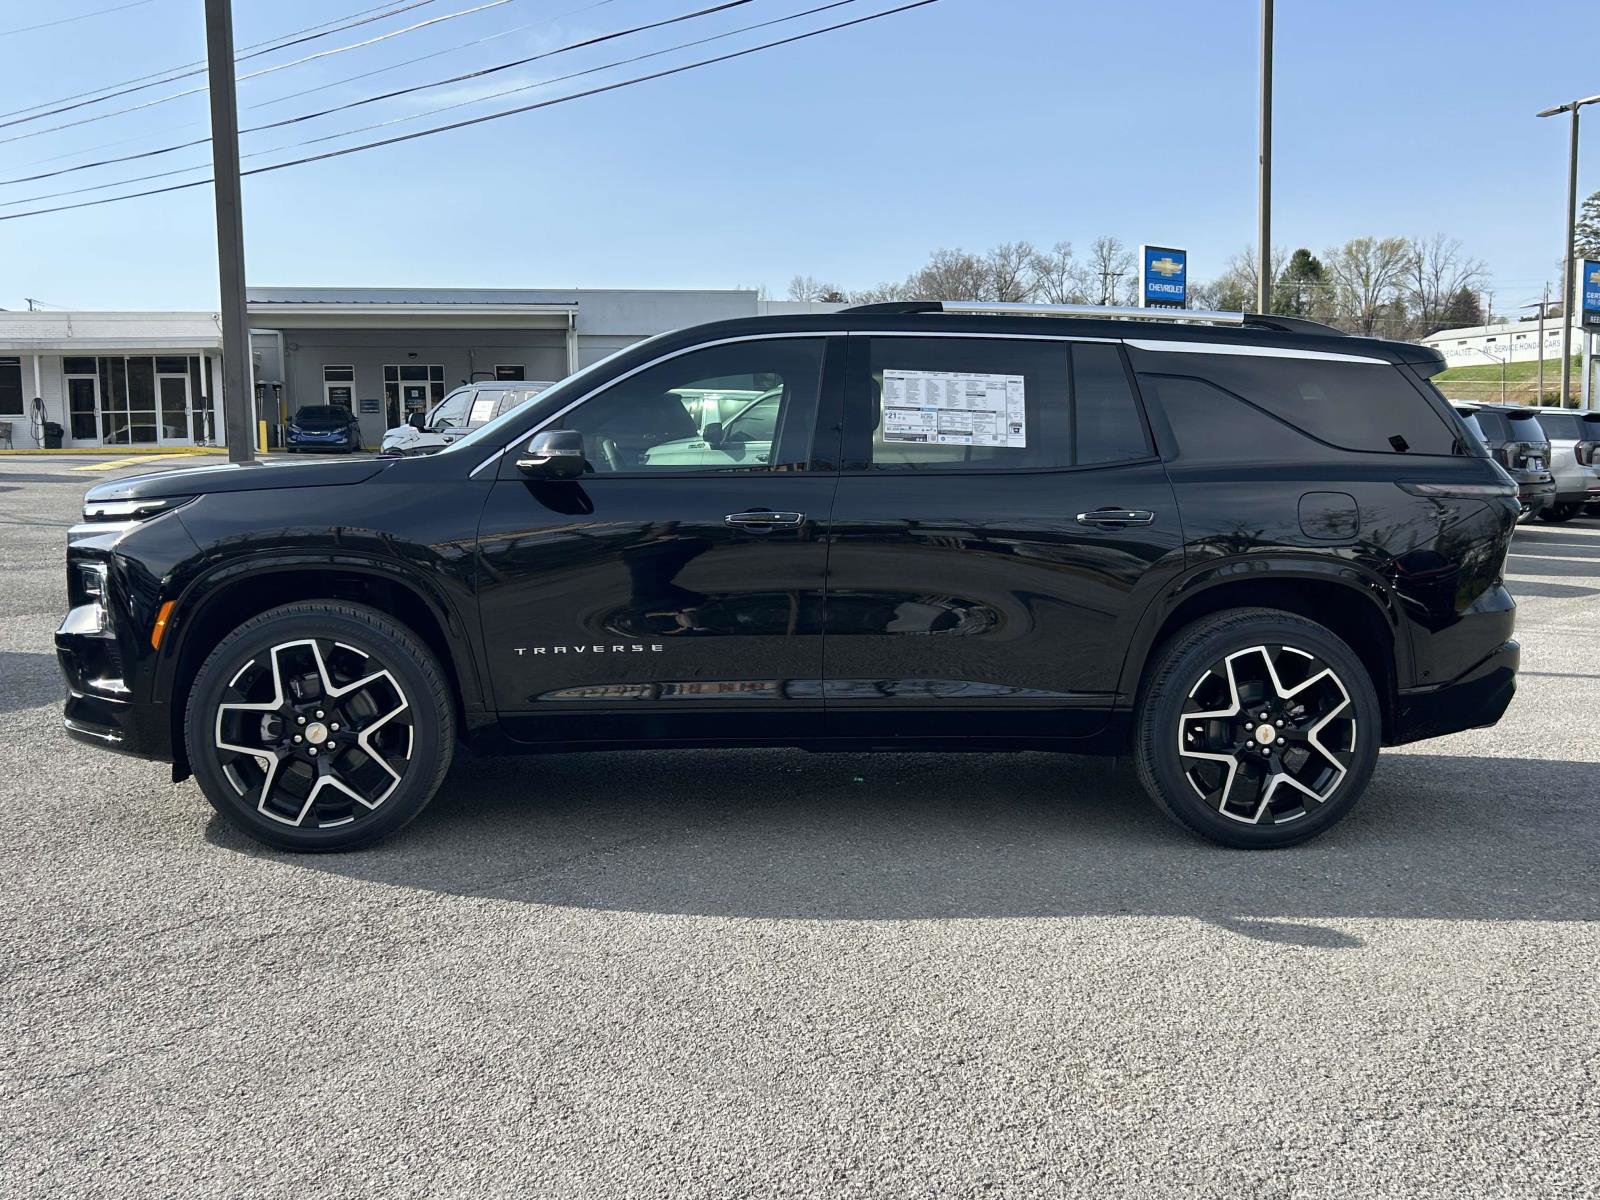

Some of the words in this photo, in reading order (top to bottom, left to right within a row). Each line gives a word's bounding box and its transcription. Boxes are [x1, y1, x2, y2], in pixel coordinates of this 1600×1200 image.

[1148, 283, 1184, 293] CHEVROLET
[1483, 344, 1491, 353] WE
[1494, 343, 1519, 353] SERVICE
[1543, 339, 1561, 348] CARS
[514, 644, 664, 656] TRAVERSE
